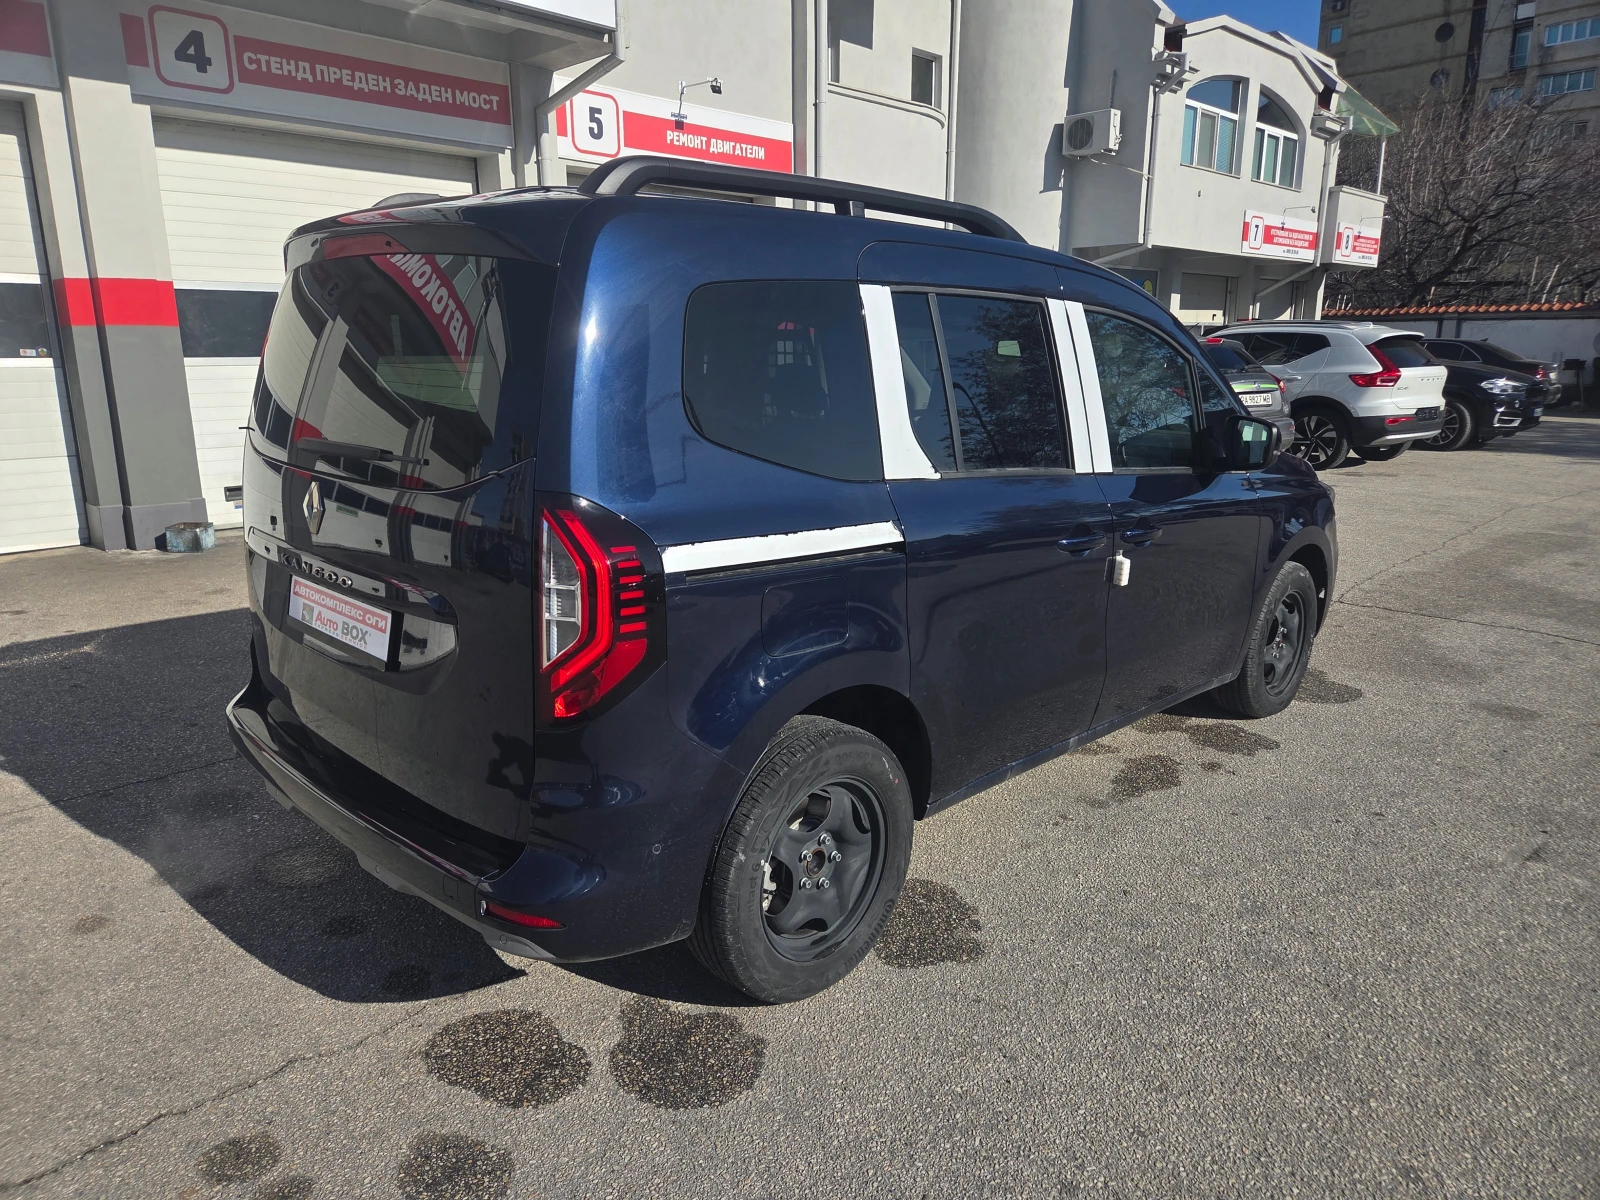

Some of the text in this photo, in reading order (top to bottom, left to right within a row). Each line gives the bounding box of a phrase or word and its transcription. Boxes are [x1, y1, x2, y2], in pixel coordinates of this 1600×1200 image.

[174, 29, 212, 74] 4
[243, 51, 500, 111] СТЕНД ПРЕДЕН ЗАДЕН МОСТ
[588, 106, 604, 140] 5
[666, 130, 765, 160] РЕМОНТ ДВИГАТЕЛИ
[1254, 224, 1260, 242] 7
[1345, 234, 1350, 250] 8
[281, 552, 353, 588] KANGOO
[294, 584, 364, 620] АВТОКОМПЛЕКС
[365, 613, 386, 630] ОГИ
[341, 620, 369, 645] BOX
